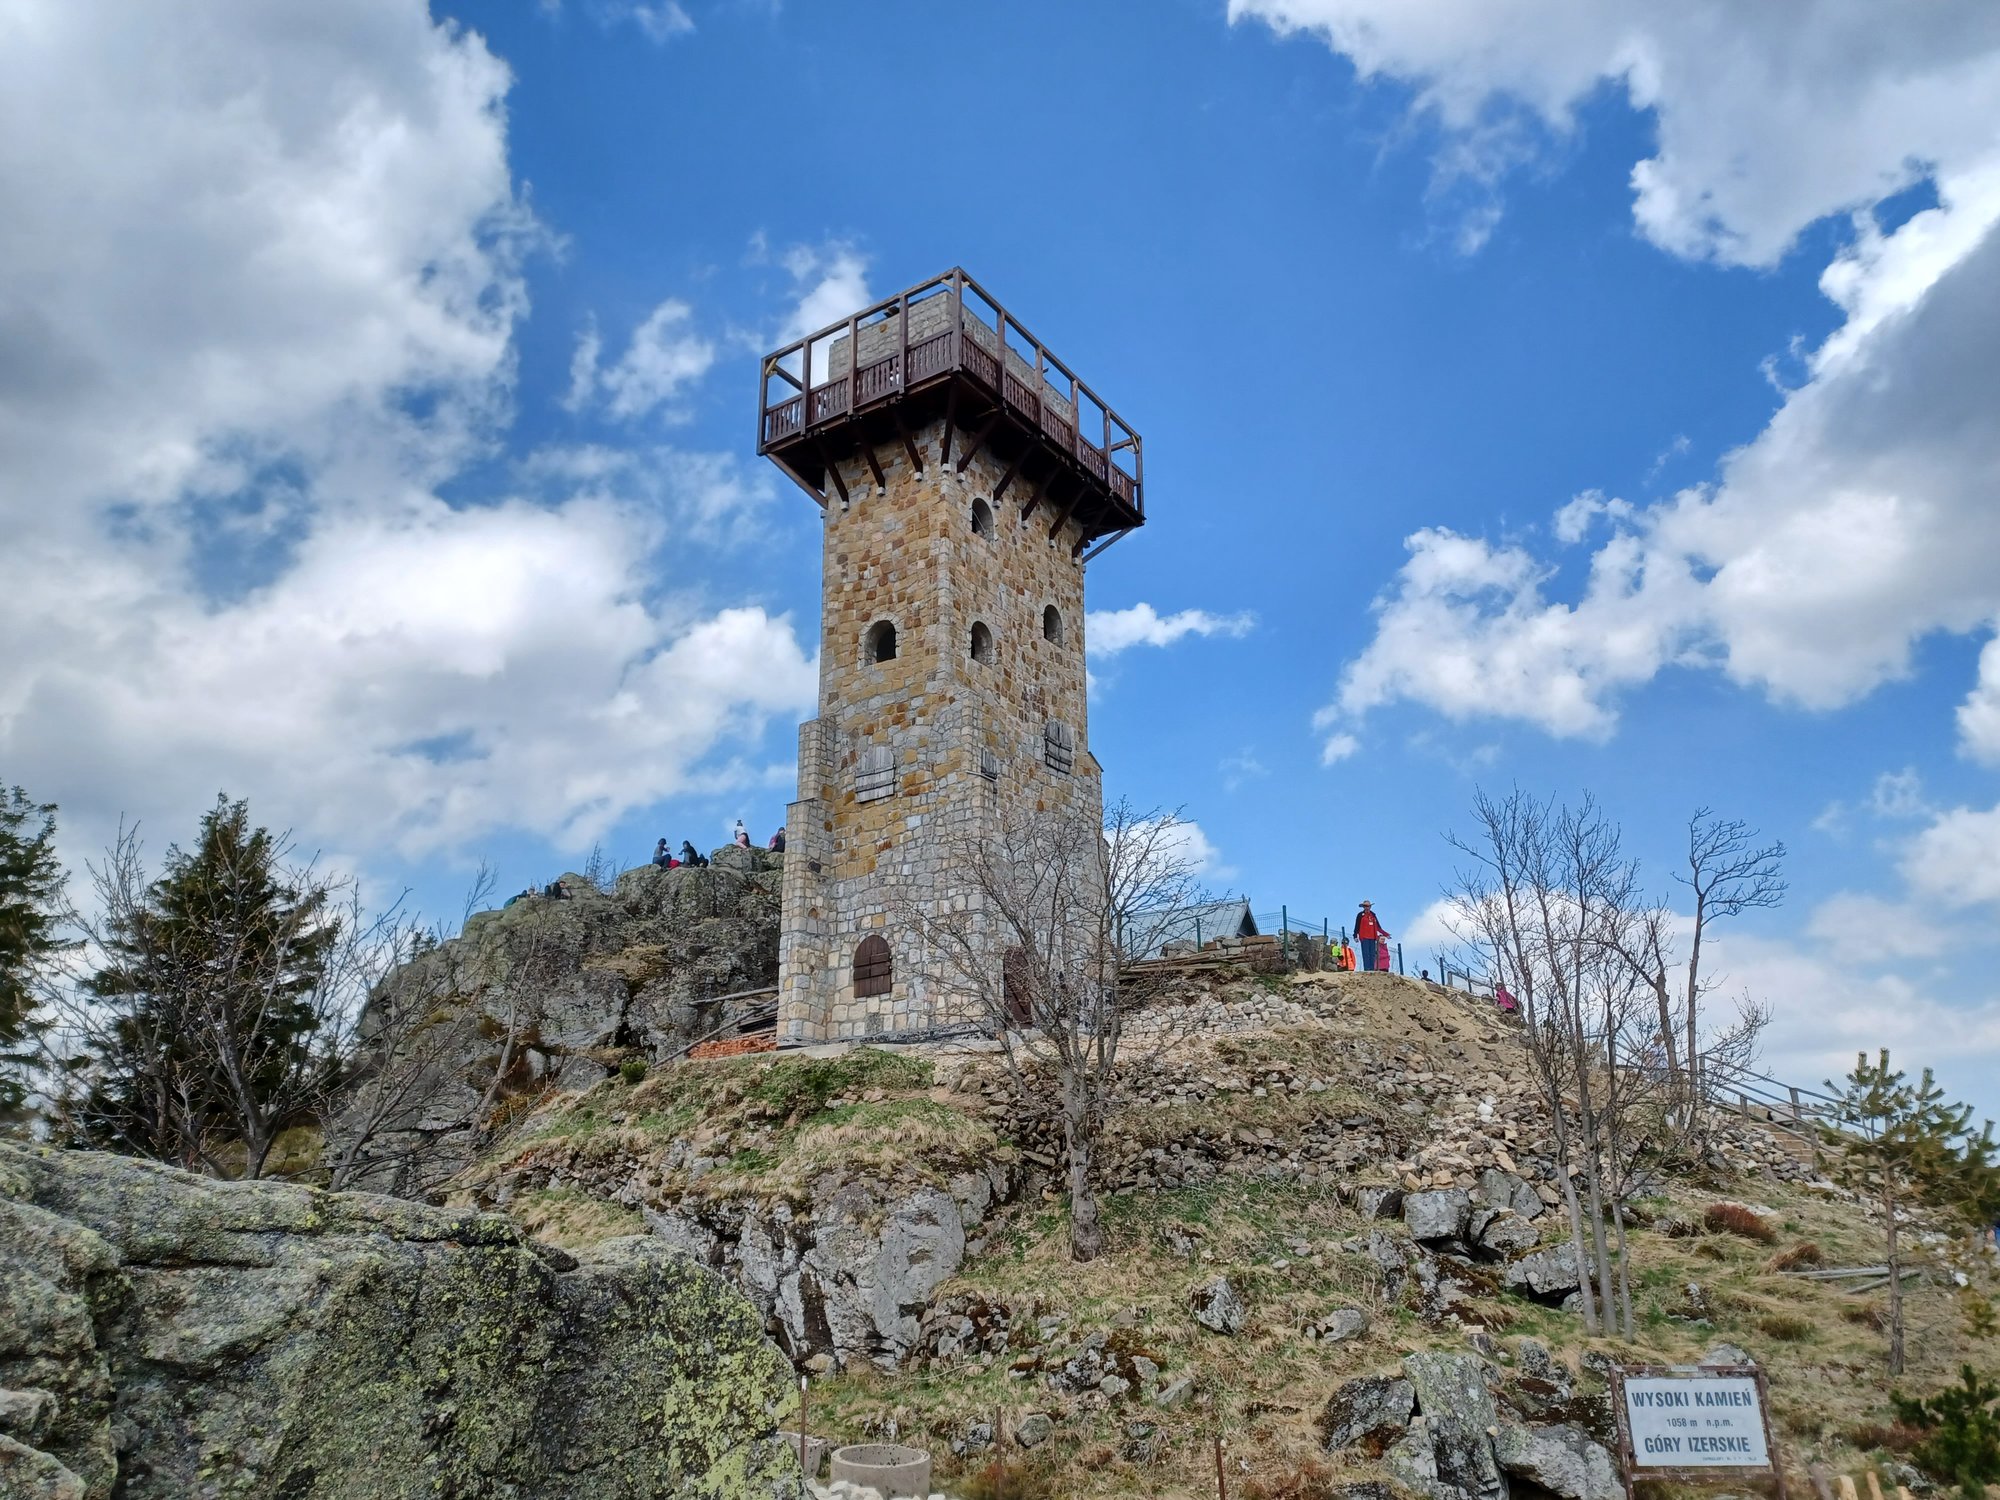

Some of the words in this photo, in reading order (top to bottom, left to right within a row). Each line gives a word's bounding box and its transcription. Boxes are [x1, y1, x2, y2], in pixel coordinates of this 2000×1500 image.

[1631, 1392, 1689, 1407] WYSOKI
[1694, 1388, 1752, 1407] KAMIEŃ
[1666, 1418, 1687, 1427] 1058
[1690, 1419, 1697, 1427] m
[1706, 1418, 1733, 1428] n.p.m.
[1644, 1434, 1681, 1453] GÓRY
[1688, 1437, 1750, 1453] IZERSKIE
